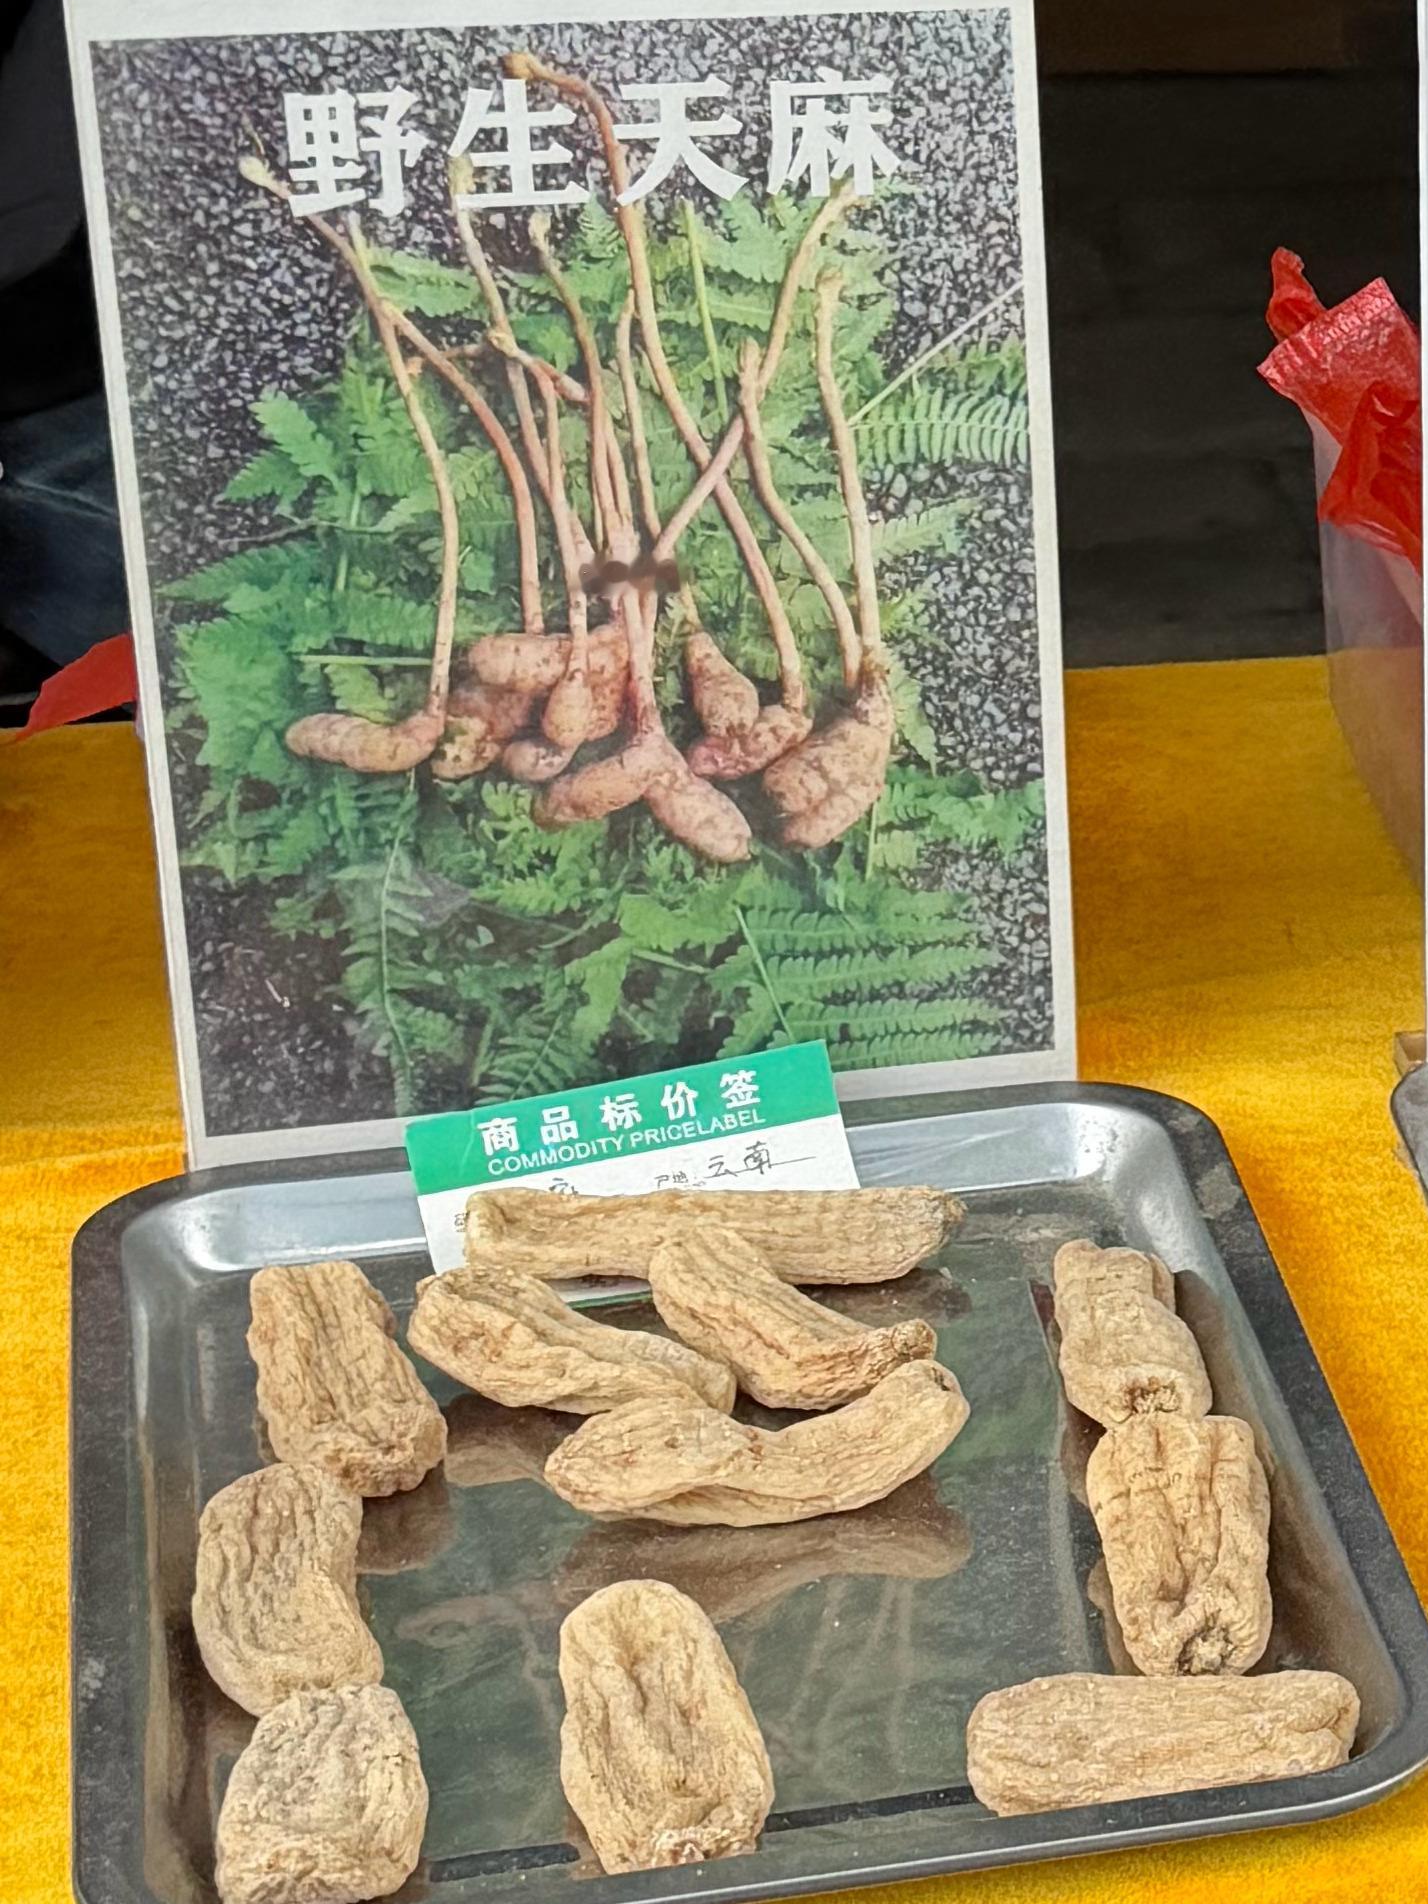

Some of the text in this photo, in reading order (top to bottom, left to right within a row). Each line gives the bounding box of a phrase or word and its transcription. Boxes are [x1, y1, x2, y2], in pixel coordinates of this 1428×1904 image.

[282, 70, 908, 218] 野生天麻
[477, 1069, 761, 1156] 商品标价签
[488, 1108, 767, 1176] COMMODITY PRICELABEL
